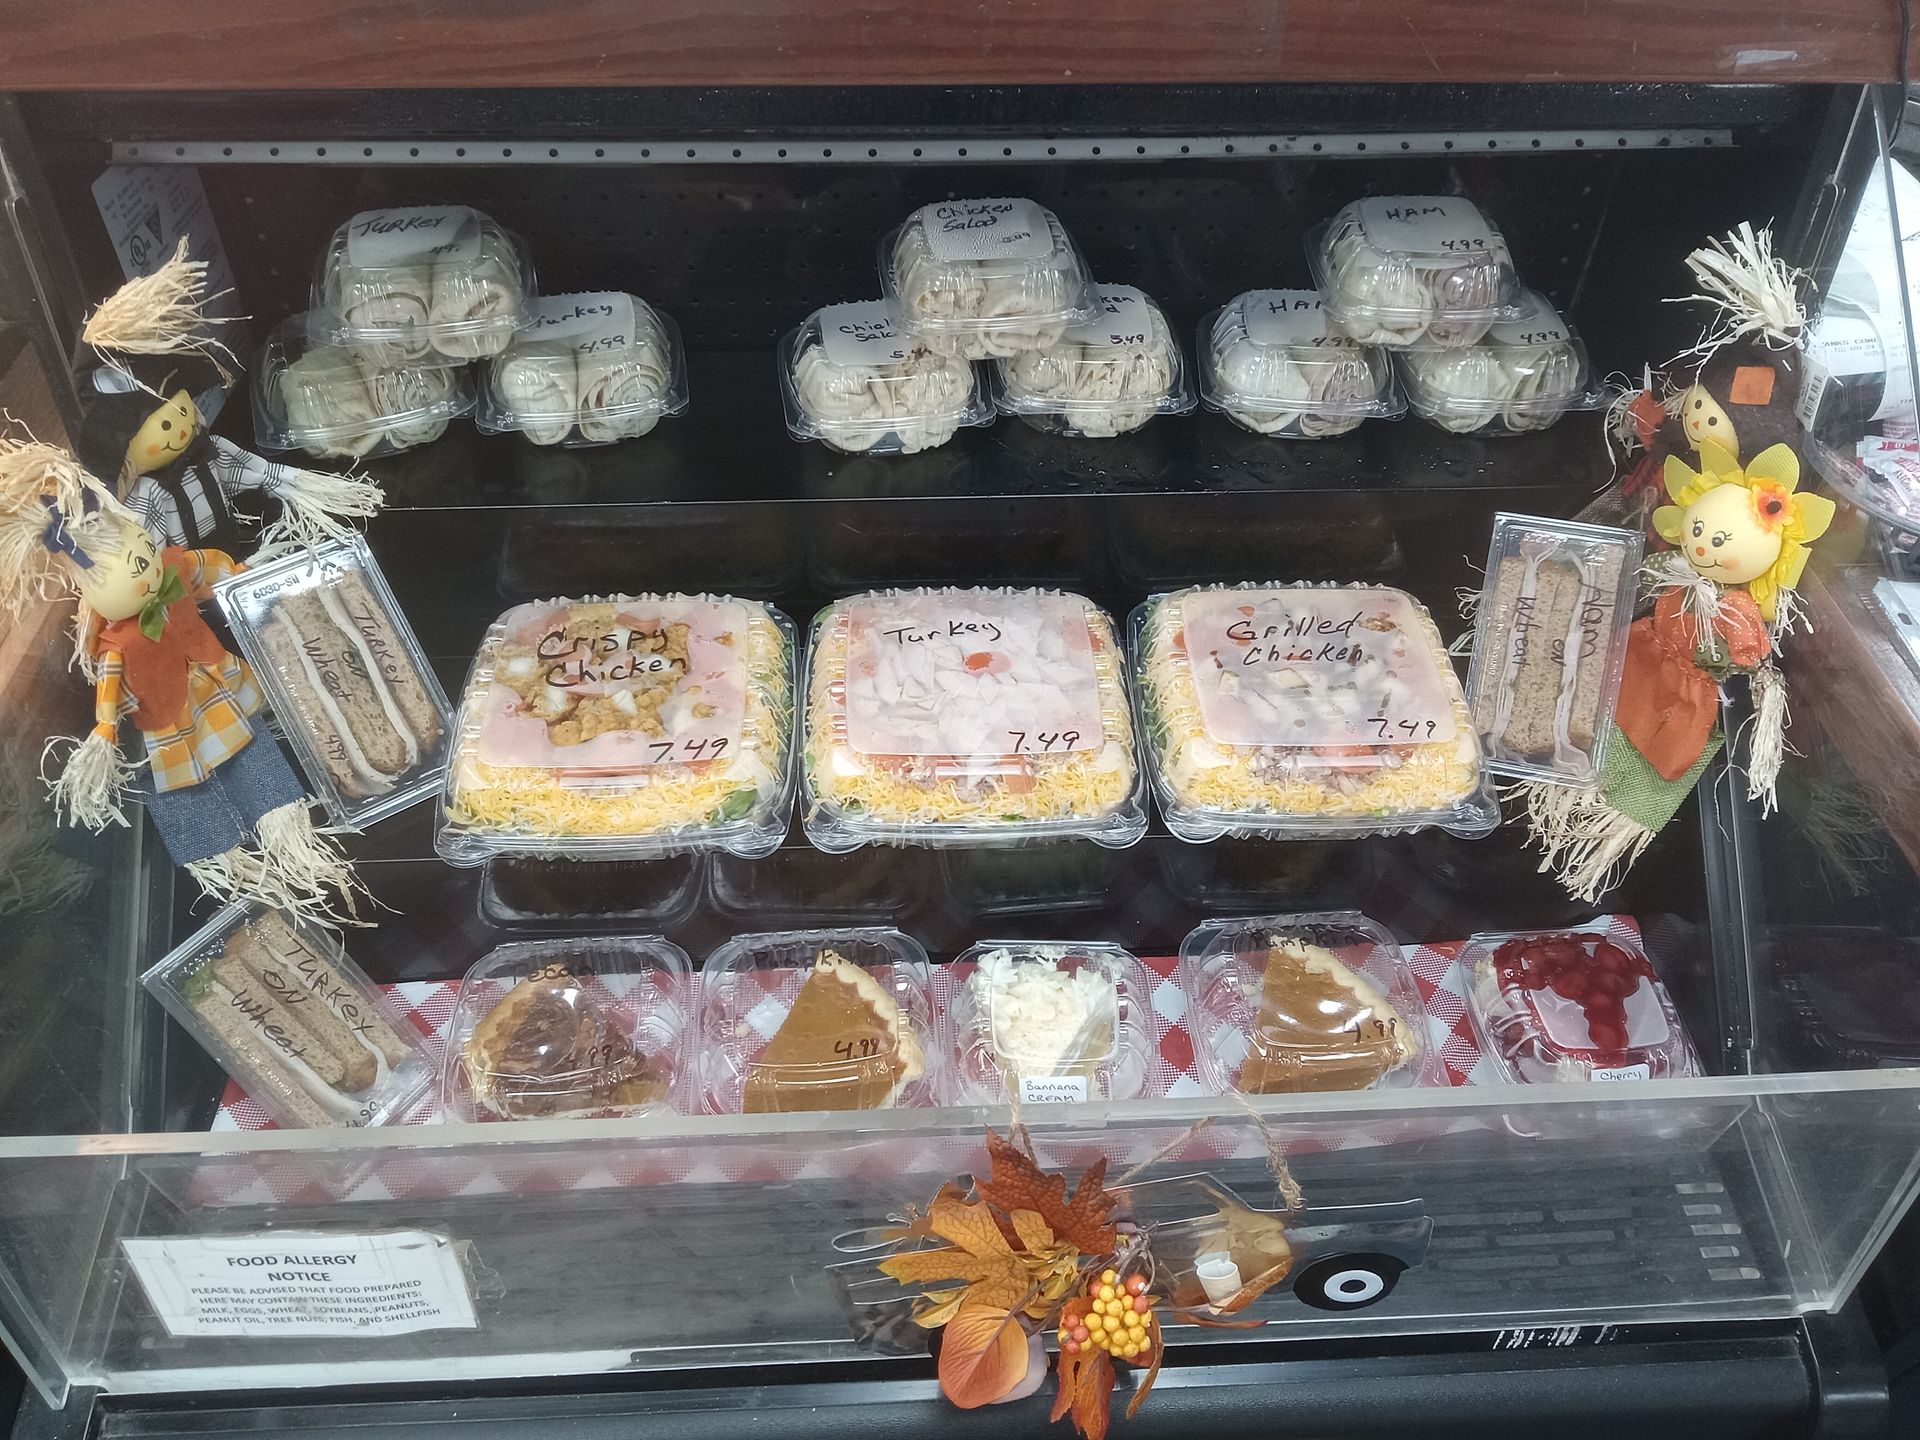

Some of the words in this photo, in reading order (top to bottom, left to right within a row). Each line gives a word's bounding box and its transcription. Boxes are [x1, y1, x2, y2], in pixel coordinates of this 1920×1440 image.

[1385, 206, 1446, 220] HAM
[1441, 238, 1485, 251] 4.99
[579, 334, 626, 354] 4.99
[1110, 333, 1145, 346] 5.49
[1520, 330, 1561, 344] 4.99
[883, 620, 1002, 646] Turkey
[1226, 610, 1363, 641] Grilled
[536, 626, 669, 660] Crispy
[1243, 642, 1363, 666] Chicken
[545, 656, 688, 688] Chicken
[1366, 717, 1437, 739] 7.49
[648, 737, 729, 763] 7.49
[1008, 730, 1081, 754] 7.49
[230, 988, 308, 1059] Wheat
[834, 1038, 880, 1060] 4.99
[1027, 1094, 1075, 1103] CREAM
[226, 1255, 279, 1267] FOOD
[283, 1254, 357, 1266] ALLERGY
[267, 1271, 332, 1282] NOTICE
[190, 1287, 231, 1295] PLEASE
[232, 1287, 247, 1295] BE
[249, 1286, 297, 1295] ADVISED
[298, 1286, 327, 1294] THAT
[329, 1286, 361, 1294] FOOD
[363, 1279, 422, 1293] PREPARED
[199, 1296, 231, 1304] HERE
[257, 1296, 308, 1305] CONTAIN
[310, 1296, 342, 1304] THESE
[344, 1290, 423, 1304] INGREDIENTS:
[200, 1306, 233, 1315] MILK,
[233, 1306, 267, 1315] EGGS,
[374, 1299, 430, 1313] PEANUTS,
[197, 1316, 242, 1324] PEANUT
[243, 1316, 266, 1325] OIL,
[266, 1316, 295, 1324] TREE
[329, 1316, 357, 1324] FISH,
[358, 1315, 383, 1324] AND
[384, 1308, 441, 1323] SHELLFISH
